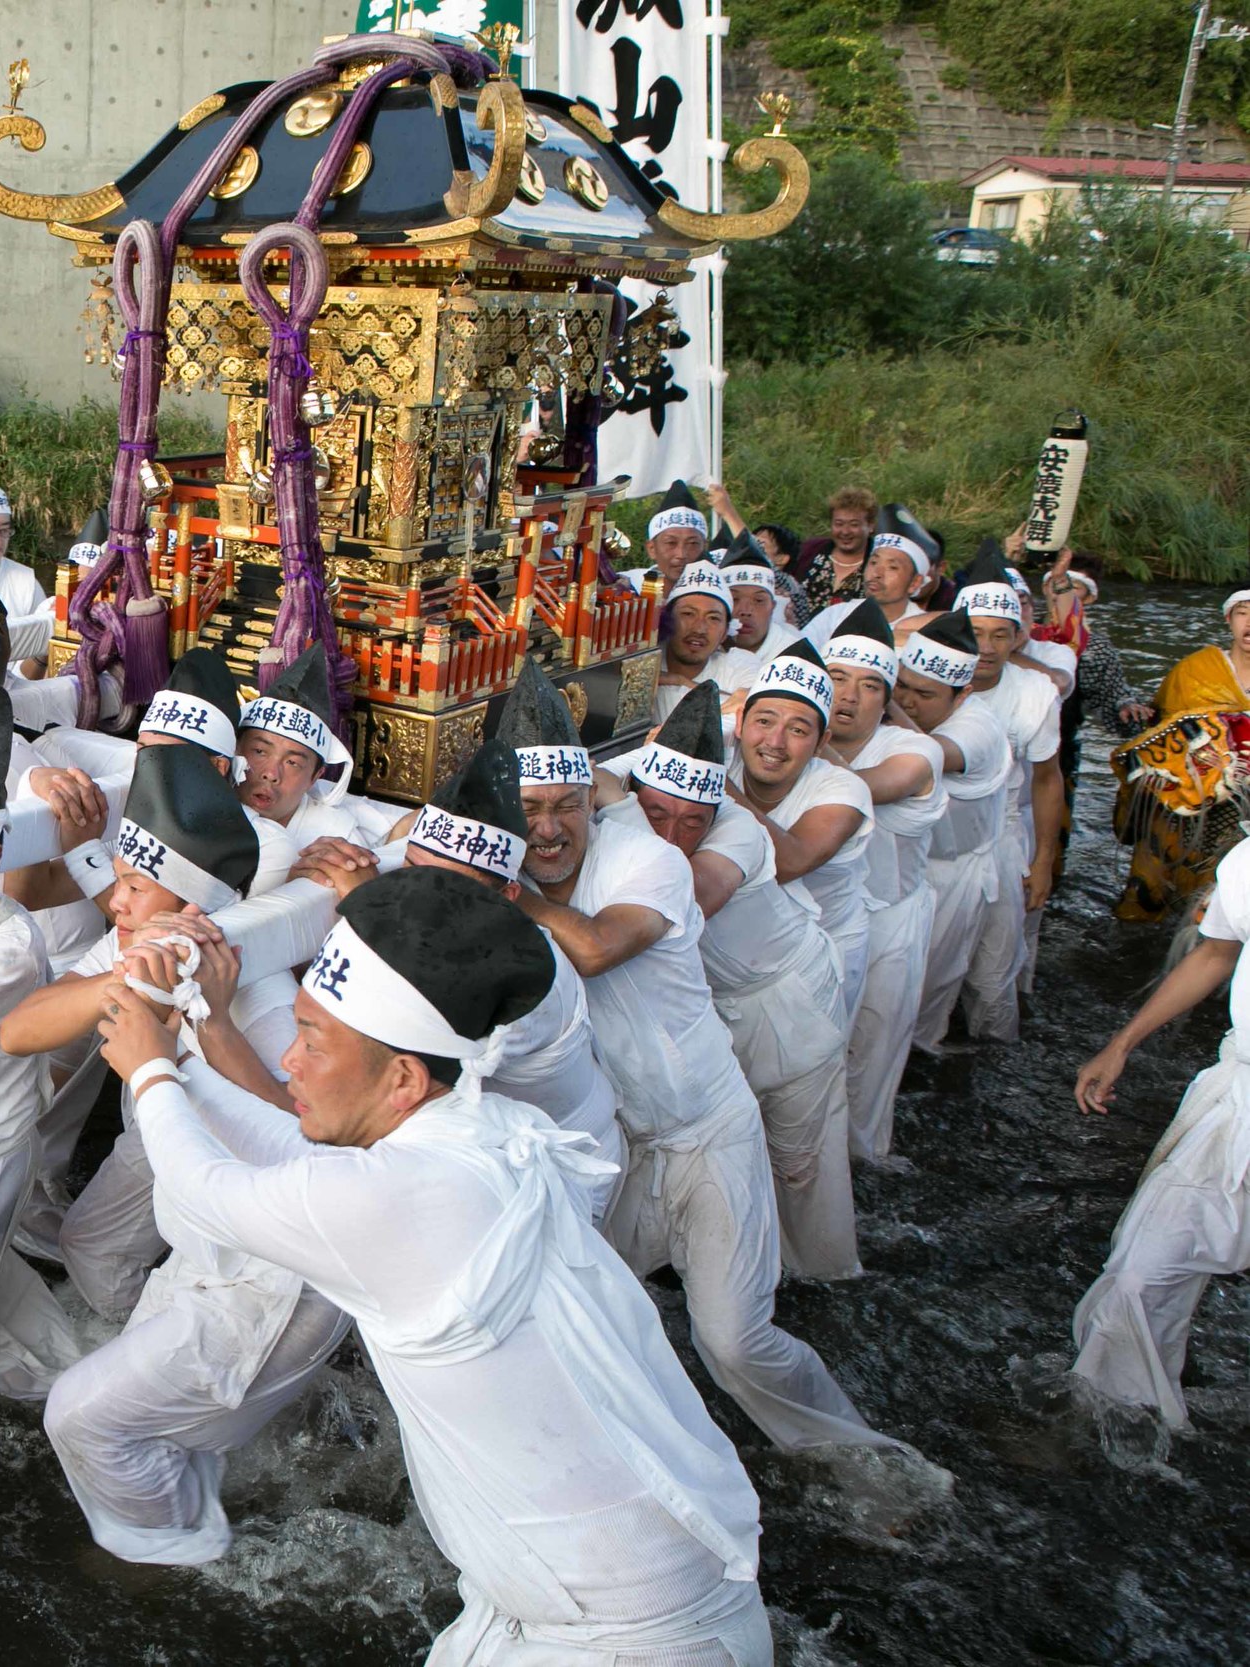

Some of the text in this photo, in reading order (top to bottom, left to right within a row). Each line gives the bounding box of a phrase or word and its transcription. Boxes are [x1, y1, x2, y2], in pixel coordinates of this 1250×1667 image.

[1027, 443, 1070, 545] 安渡虎舞
[641, 750, 725, 801] 小鎚神社
